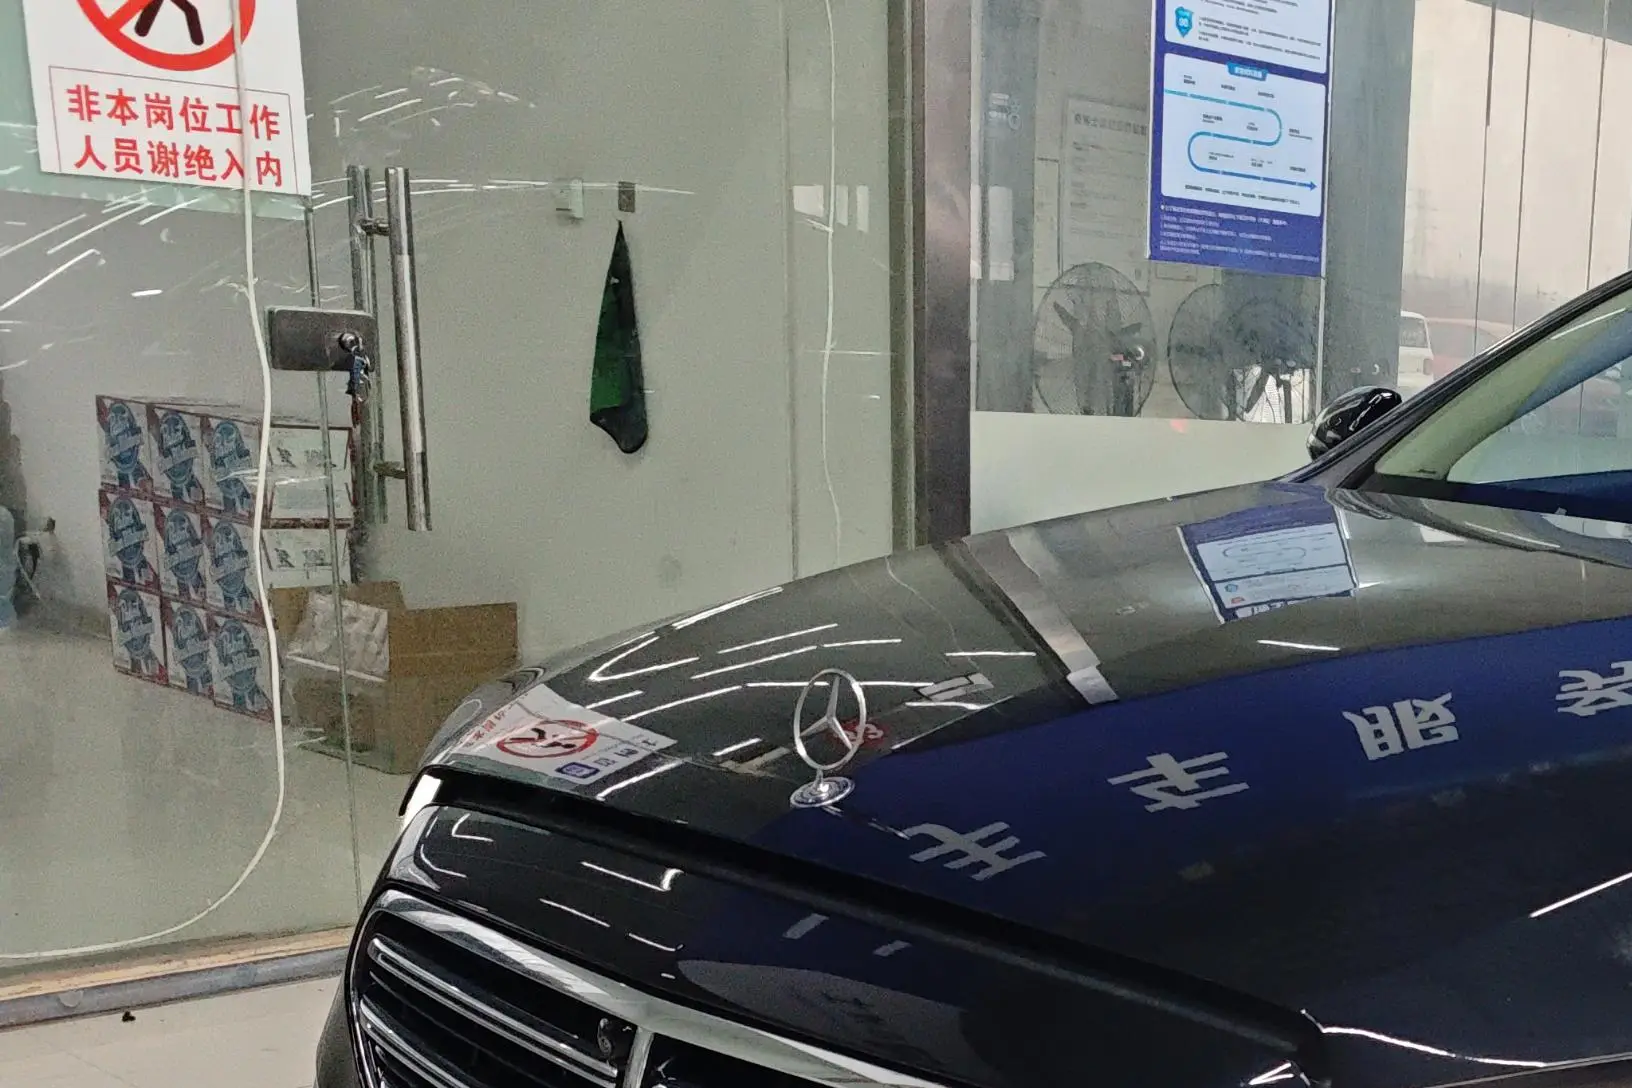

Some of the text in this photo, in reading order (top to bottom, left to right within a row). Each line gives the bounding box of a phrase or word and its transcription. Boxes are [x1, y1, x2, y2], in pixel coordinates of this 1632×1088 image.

[66, 84, 281, 141] 非本岗位工作
[74, 135, 283, 188] 人员谢绝入内
